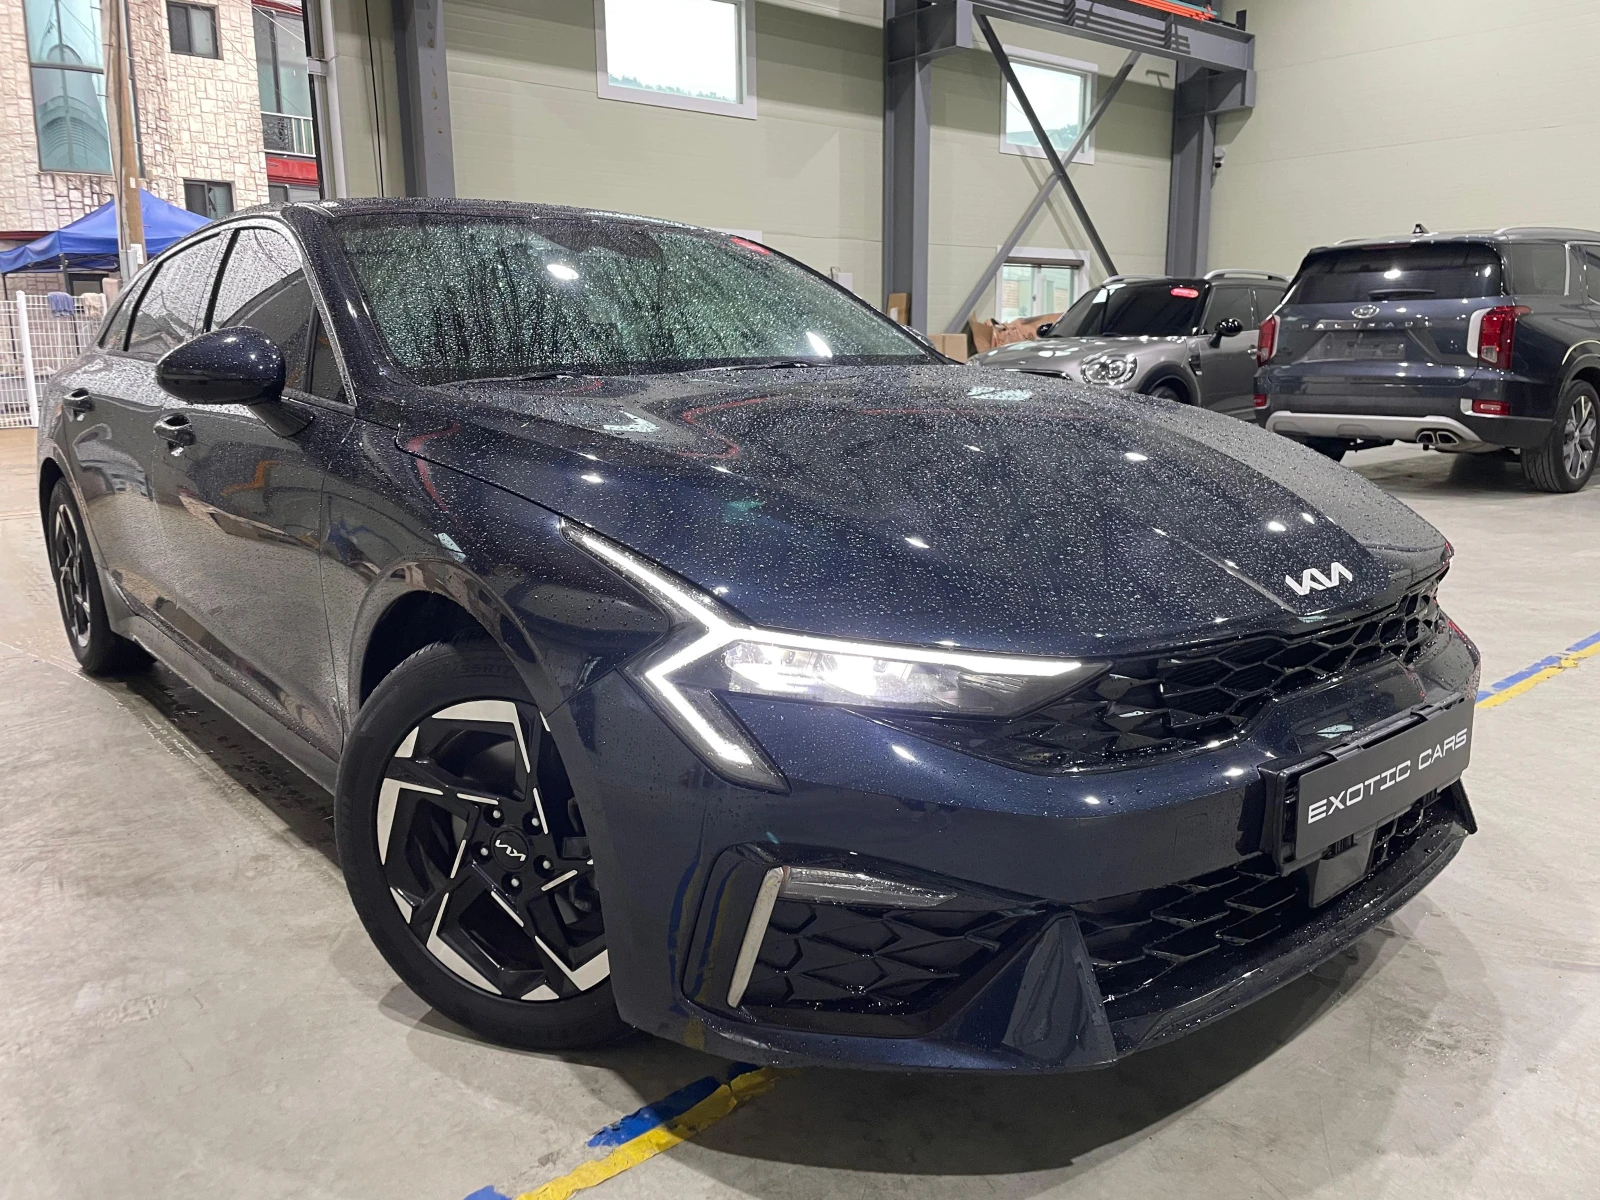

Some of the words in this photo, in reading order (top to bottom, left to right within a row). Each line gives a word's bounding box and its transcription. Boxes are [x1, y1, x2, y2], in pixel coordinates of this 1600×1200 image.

[1286, 562, 1353, 596] KIA
[1307, 760, 1411, 825] EXOTIC
[1418, 728, 1468, 771] CARS
[495, 839, 526, 861] KIA
